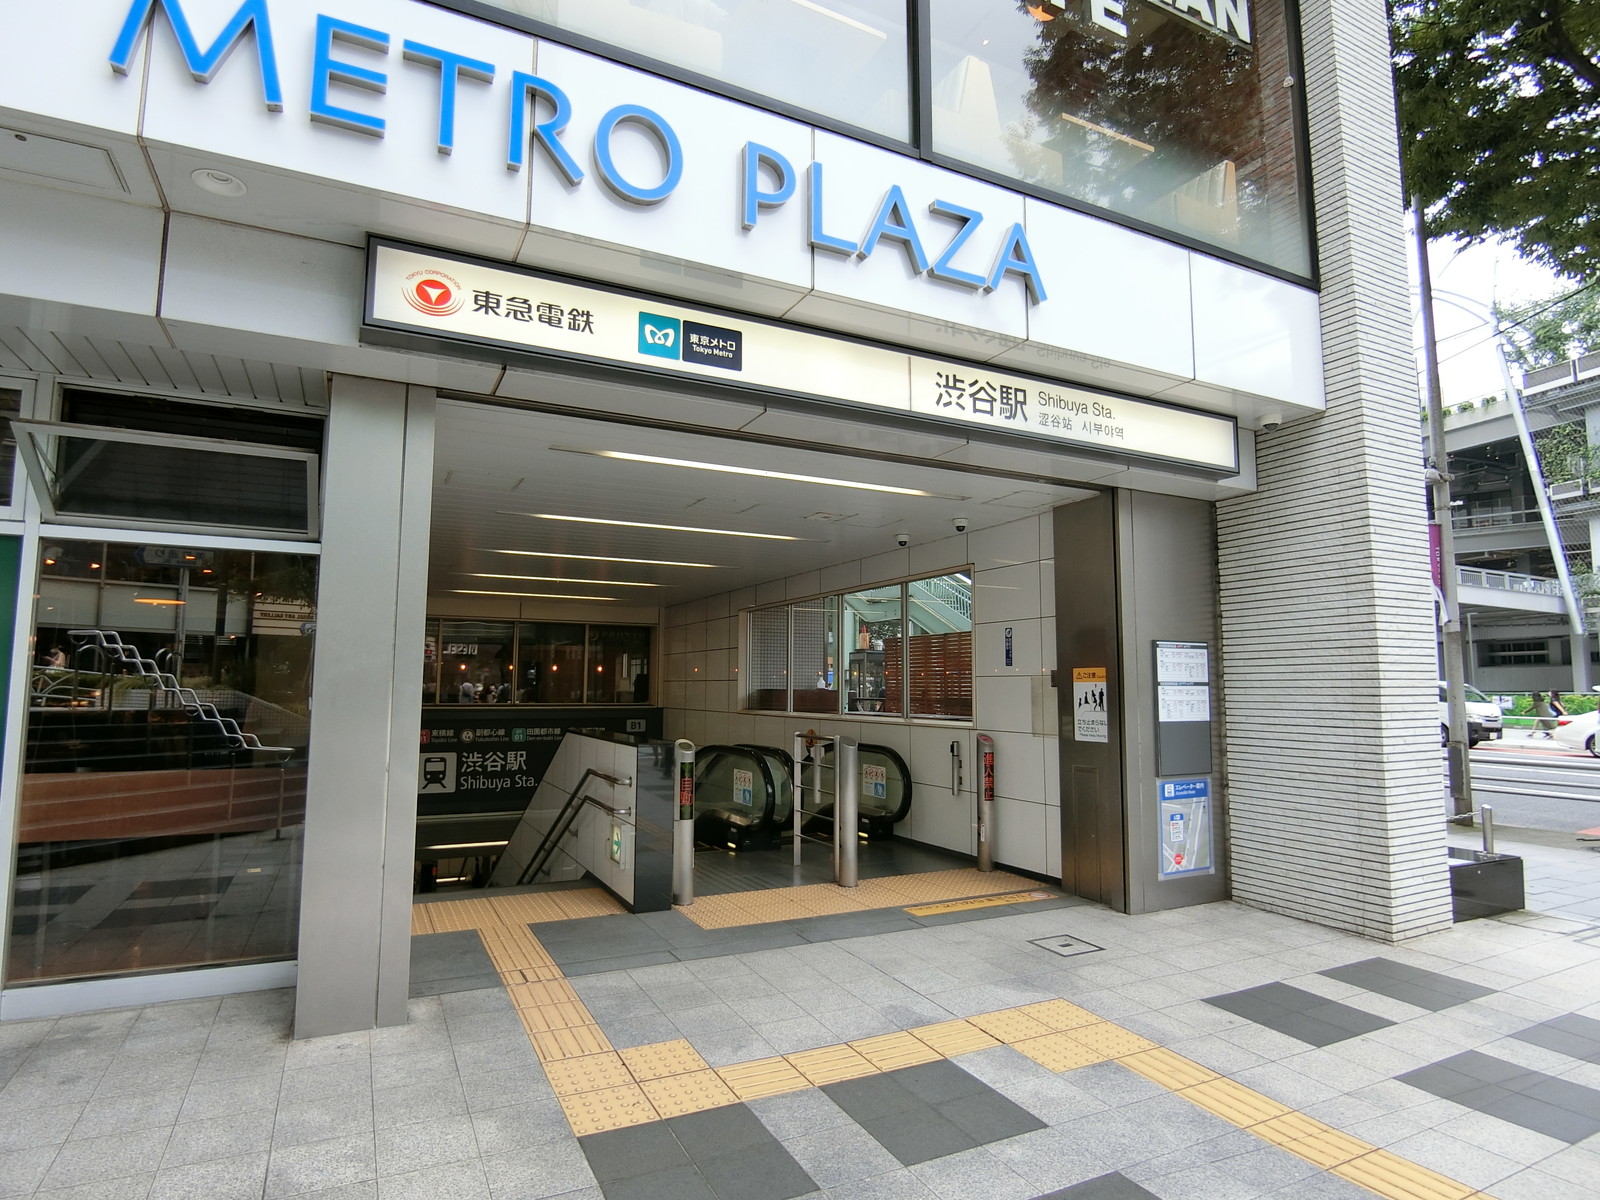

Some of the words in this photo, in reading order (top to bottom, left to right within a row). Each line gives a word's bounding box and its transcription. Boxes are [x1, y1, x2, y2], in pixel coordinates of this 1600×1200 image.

[109, 0, 684, 206] METRO
[742, 140, 1048, 306] PLAZA
[405, 270, 424, 281] TOKYU
[424, 269, 463, 291] CORPORATION
[472, 289, 595, 335] 東急電鉄
[689, 333, 736, 351] 東京メトロ
[692, 344, 713, 355] Tokyo
[713, 348, 733, 359] Metro
[935, 371, 1028, 422] 渋谷駅
[1038, 391, 1089, 417] Shibuya
[1092, 402, 1117, 420] Sta.
[1082, 420, 1125, 441] 시부야역
[475, 728, 506, 737] 副都心線
[526, 728, 561, 736] 田園都市線
[631, 722, 642, 730] B1
[460, 750, 527, 773] 渋谷駅
[460, 775, 511, 792] Shibuya
[516, 773, 539, 787] Sta.
[984, 752, 995, 801] 進入禁止
[680, 777, 694, 805] 自動
